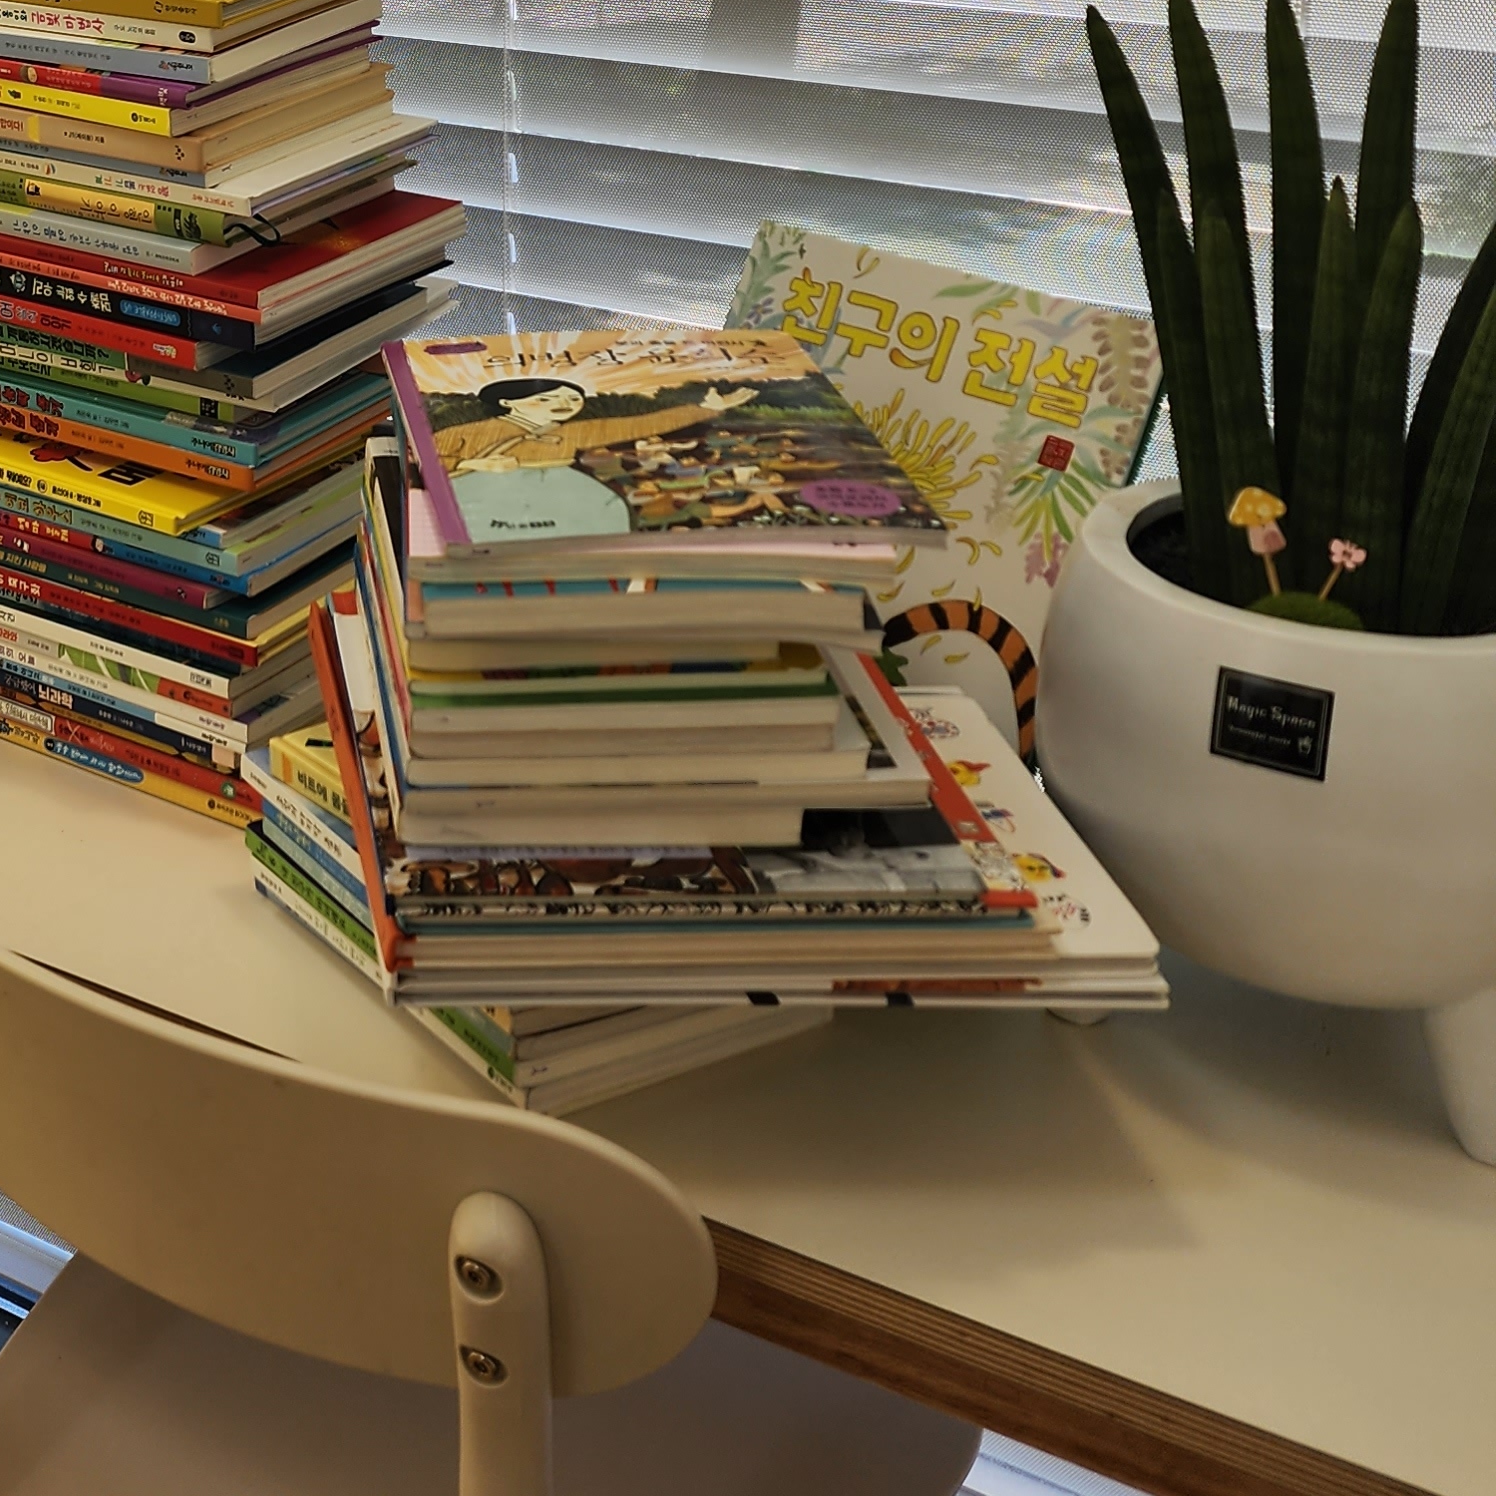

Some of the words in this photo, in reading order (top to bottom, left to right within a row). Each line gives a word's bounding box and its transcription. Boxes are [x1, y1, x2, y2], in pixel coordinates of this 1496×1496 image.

[31, 10, 61, 28] 금빛
[63, 14, 105, 34] 마법사
[31, 279, 54, 299] 우리
[55, 284, 76, 301] 없는
[76, 290, 88, 304] 수
[89, 291, 113, 312] 멈출
[5, 324, 110, 360] 개통하시겠습니까?
[781, 266, 962, 385] 친구의
[963, 326, 1101, 432] 전설
[4, 490, 31, 512] 에코
[33, 497, 74, 526] 하우스
[38, 685, 74, 711] 뇌과학
[1226, 694, 1268, 721] Magic
[296, 768, 330, 795] 비트에
